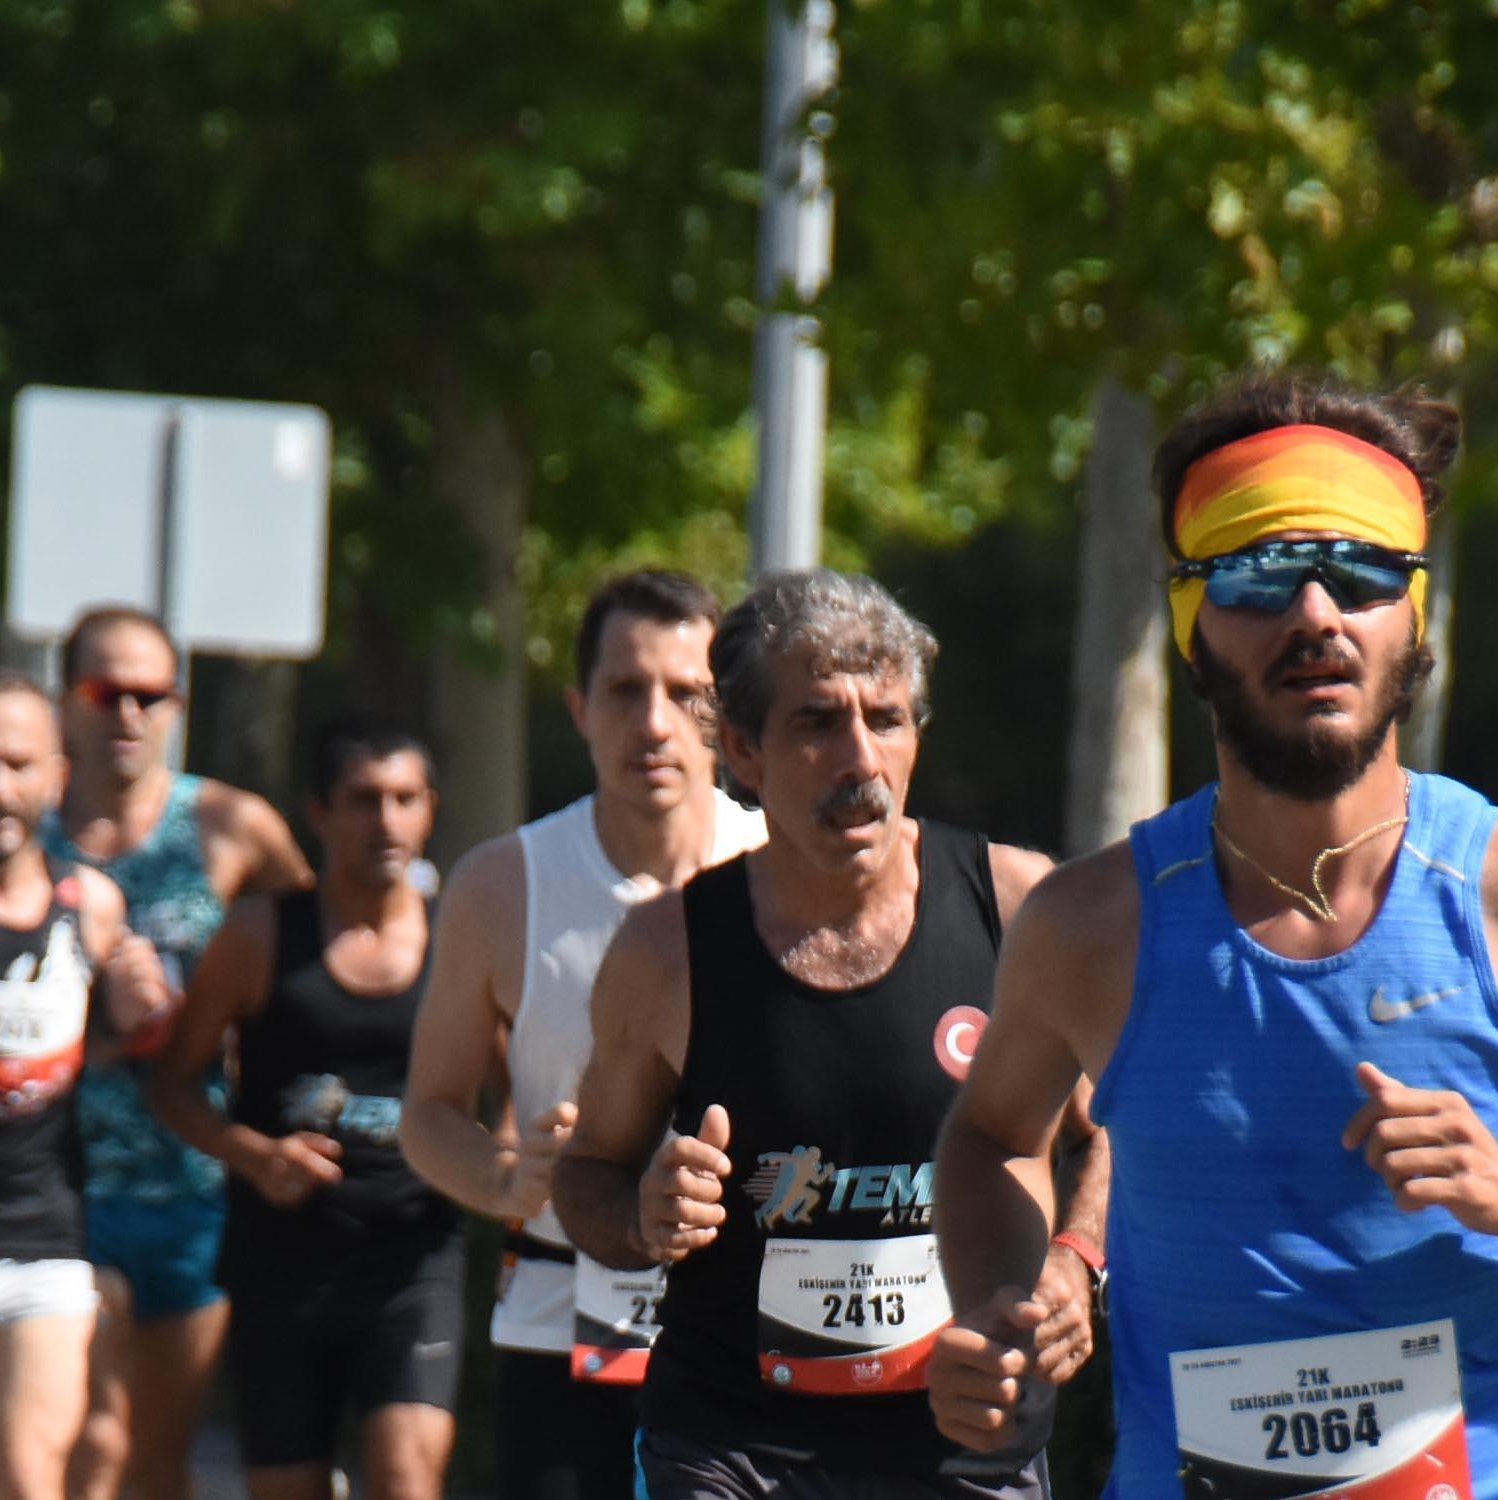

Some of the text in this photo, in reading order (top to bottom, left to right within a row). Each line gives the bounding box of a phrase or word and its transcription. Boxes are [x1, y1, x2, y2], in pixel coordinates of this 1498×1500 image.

[827, 1161, 935, 1212] TEM
[850, 1262, 874, 1277] 21K
[822, 1291, 905, 1328] 2413
[1296, 1368, 1330, 1388] 21K
[1330, 1377, 1405, 1401] MARATONU
[1262, 1401, 1381, 1460] 2064
